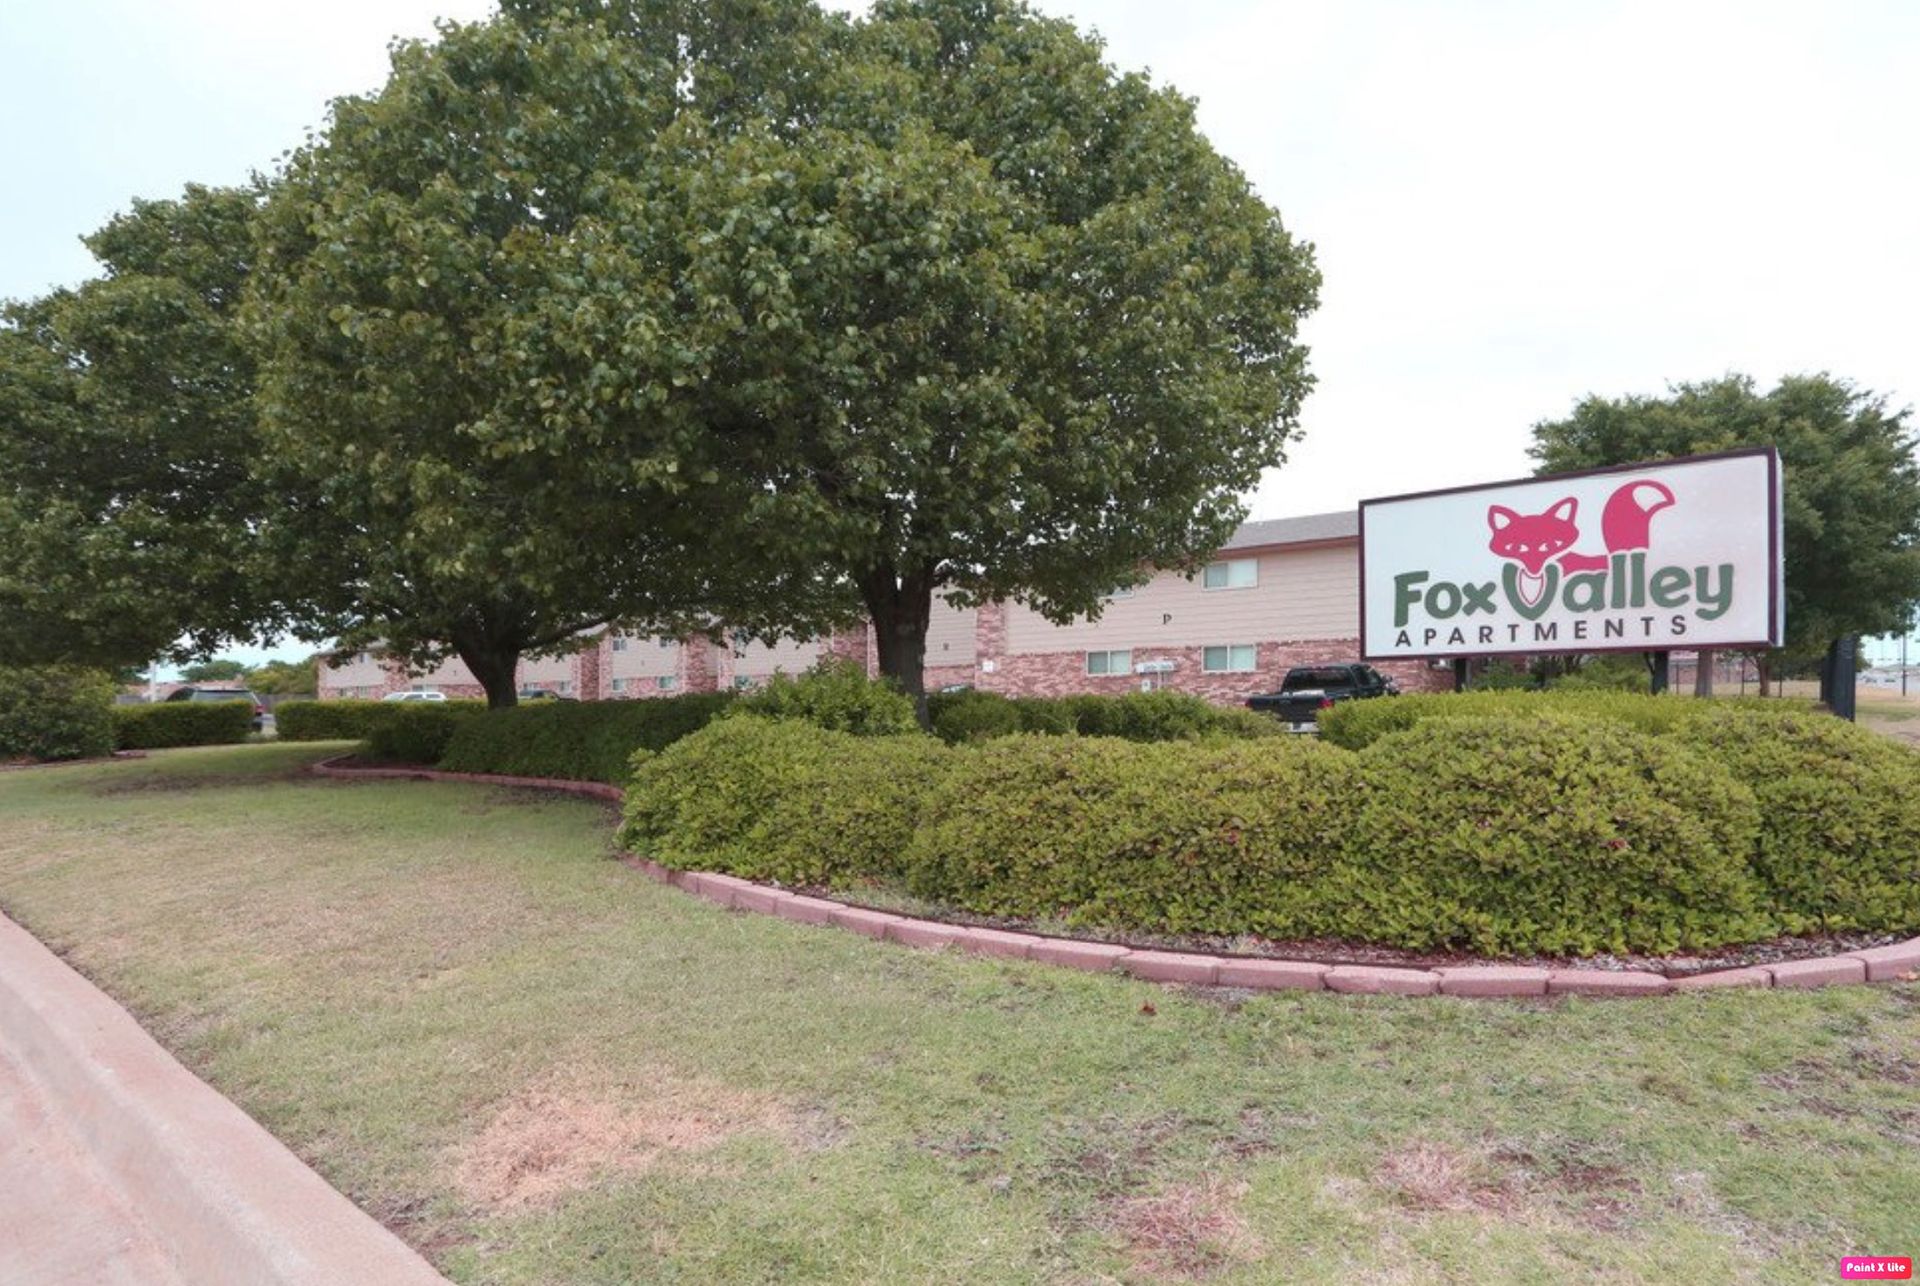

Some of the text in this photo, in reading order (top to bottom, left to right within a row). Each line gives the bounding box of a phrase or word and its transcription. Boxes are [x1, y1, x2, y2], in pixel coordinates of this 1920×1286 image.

[1393, 552, 1734, 628] Fox Valley
[1162, 613, 1173, 626] P
[1394, 614, 1687, 648] APARTMENTS
